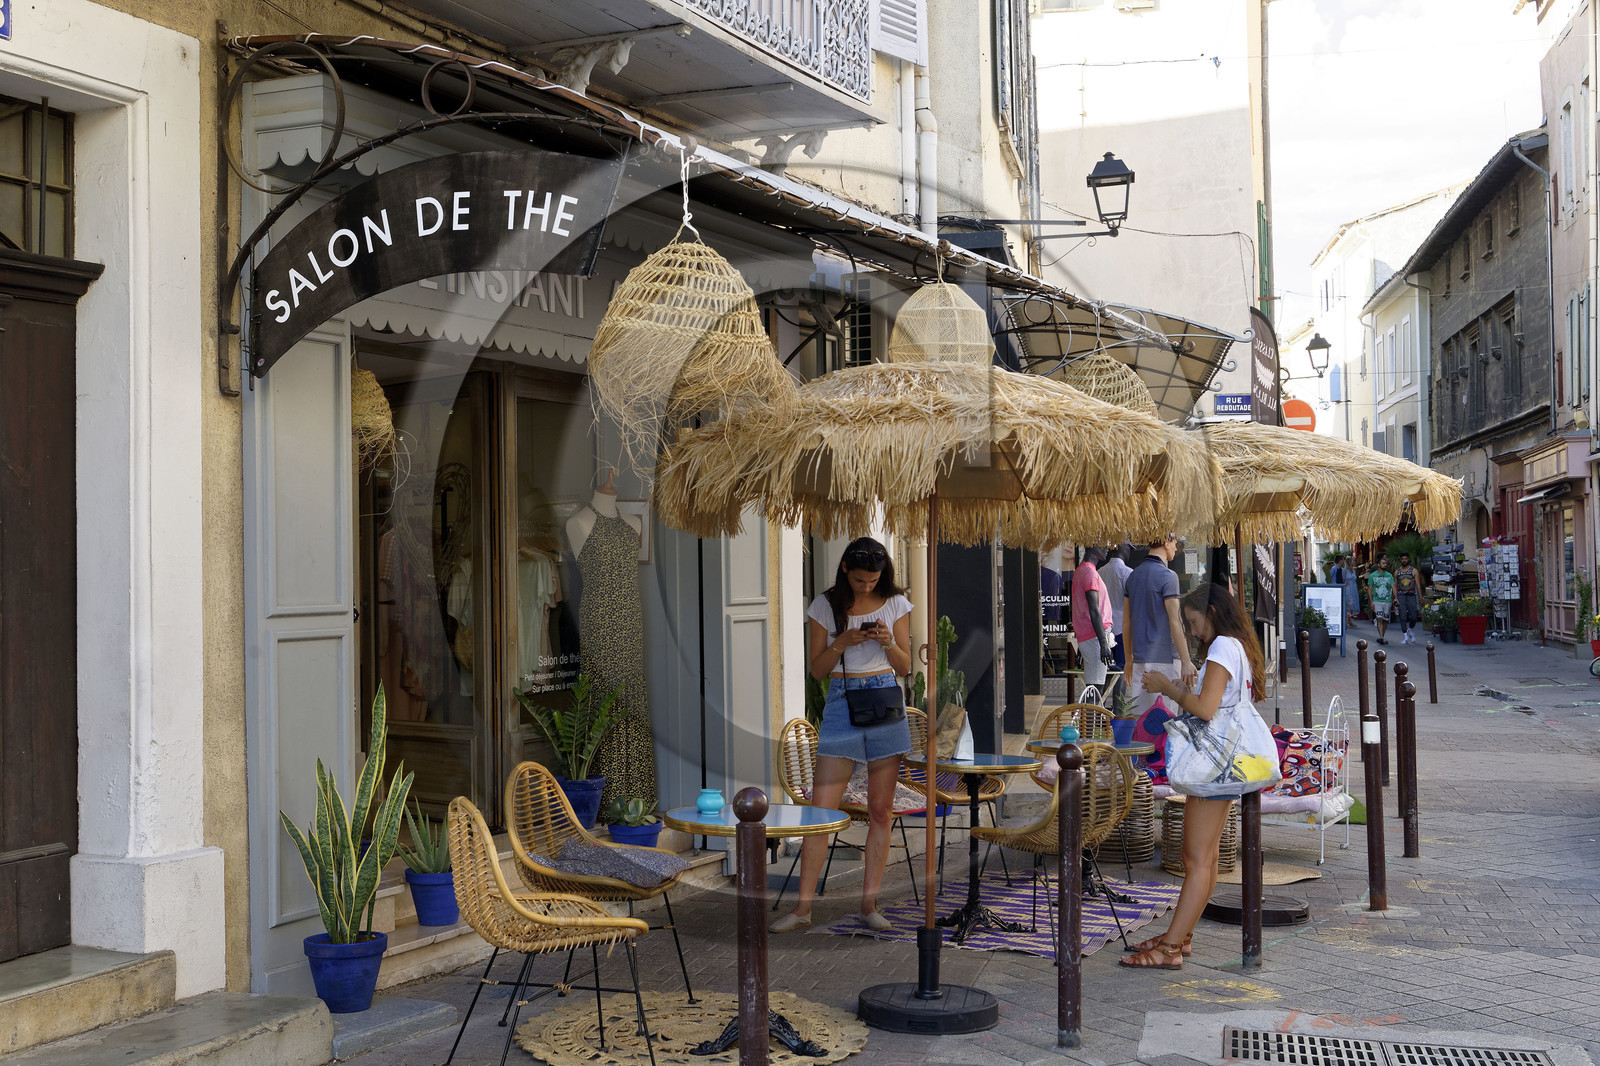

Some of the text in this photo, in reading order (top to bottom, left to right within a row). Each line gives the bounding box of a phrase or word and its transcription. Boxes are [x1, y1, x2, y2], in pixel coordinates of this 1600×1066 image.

[265, 190, 579, 324] SALON DE THE
[538, 652, 581, 667] Salon de thé
[536, 672, 554, 681] déjeuner
[532, 685, 541, 693] Sur
[542, 684, 554, 693] place
